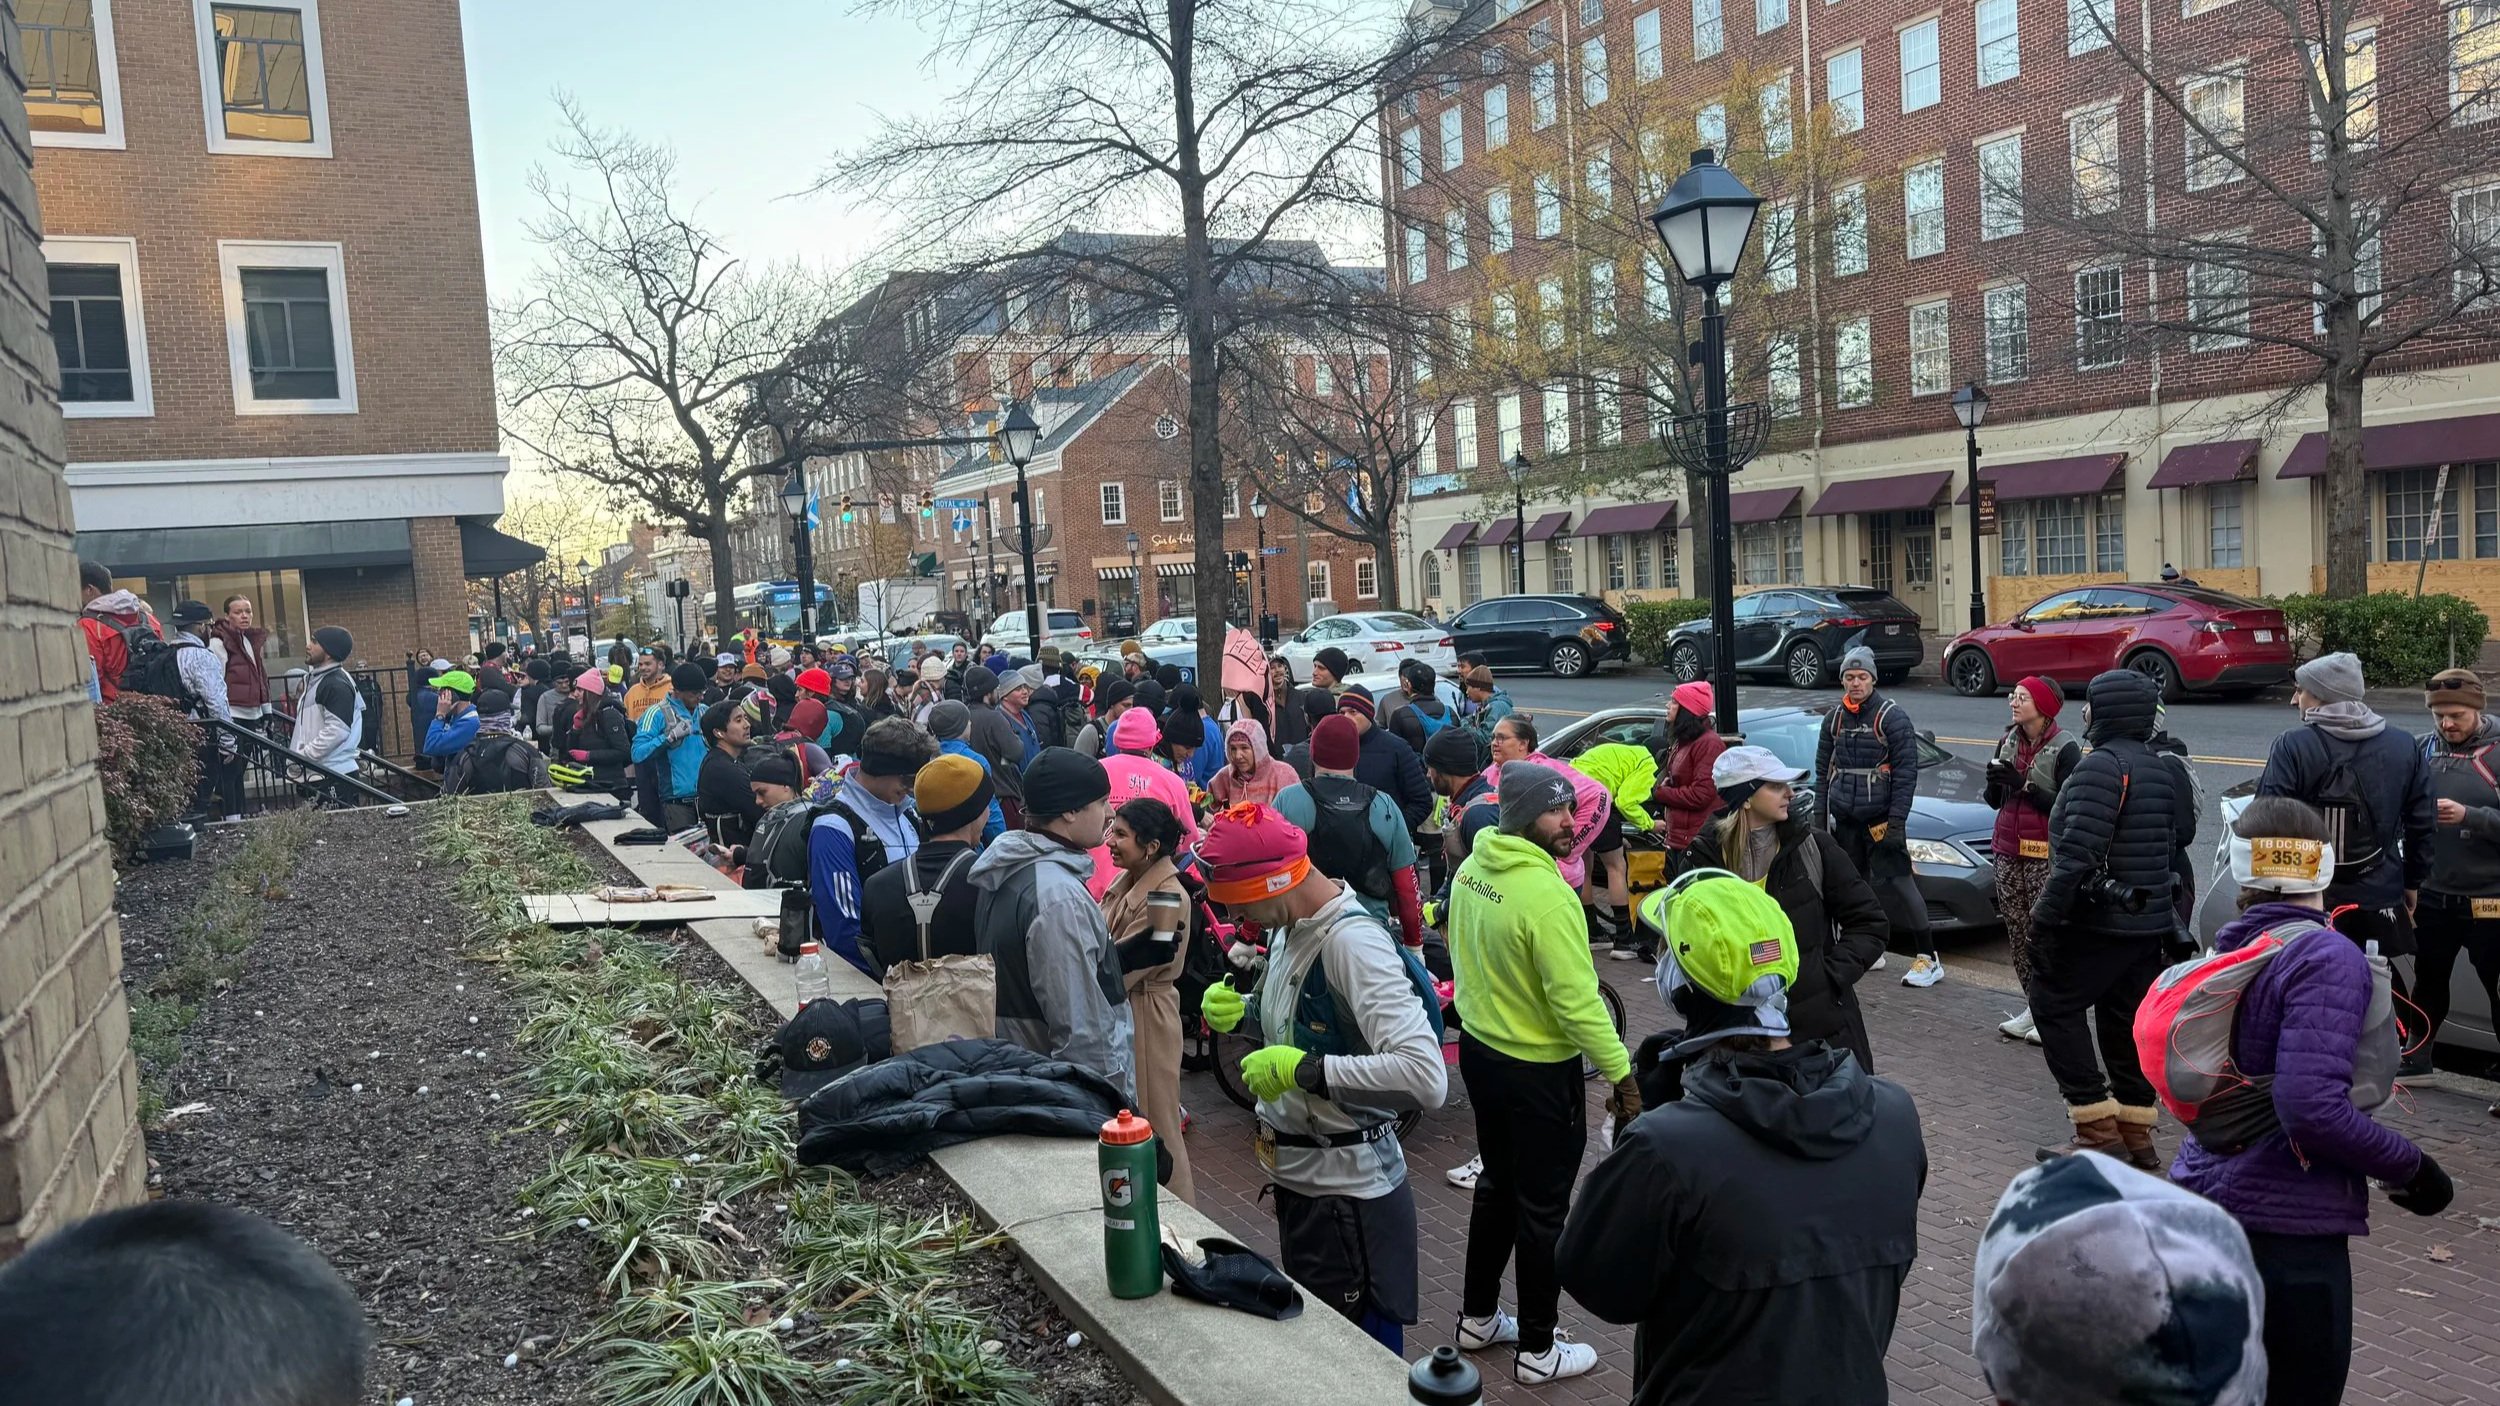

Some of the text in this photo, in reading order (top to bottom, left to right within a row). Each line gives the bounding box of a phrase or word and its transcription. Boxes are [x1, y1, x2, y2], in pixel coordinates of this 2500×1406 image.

[935, 500, 975, 508] ROYAL ST
[1151, 534, 1167, 547] Sur
[2028, 845, 2041, 853] 622
[2260, 839, 2316, 852] TB DC 50K
[2271, 850, 2302, 866] 353
[2482, 904, 2498, 912] 654
